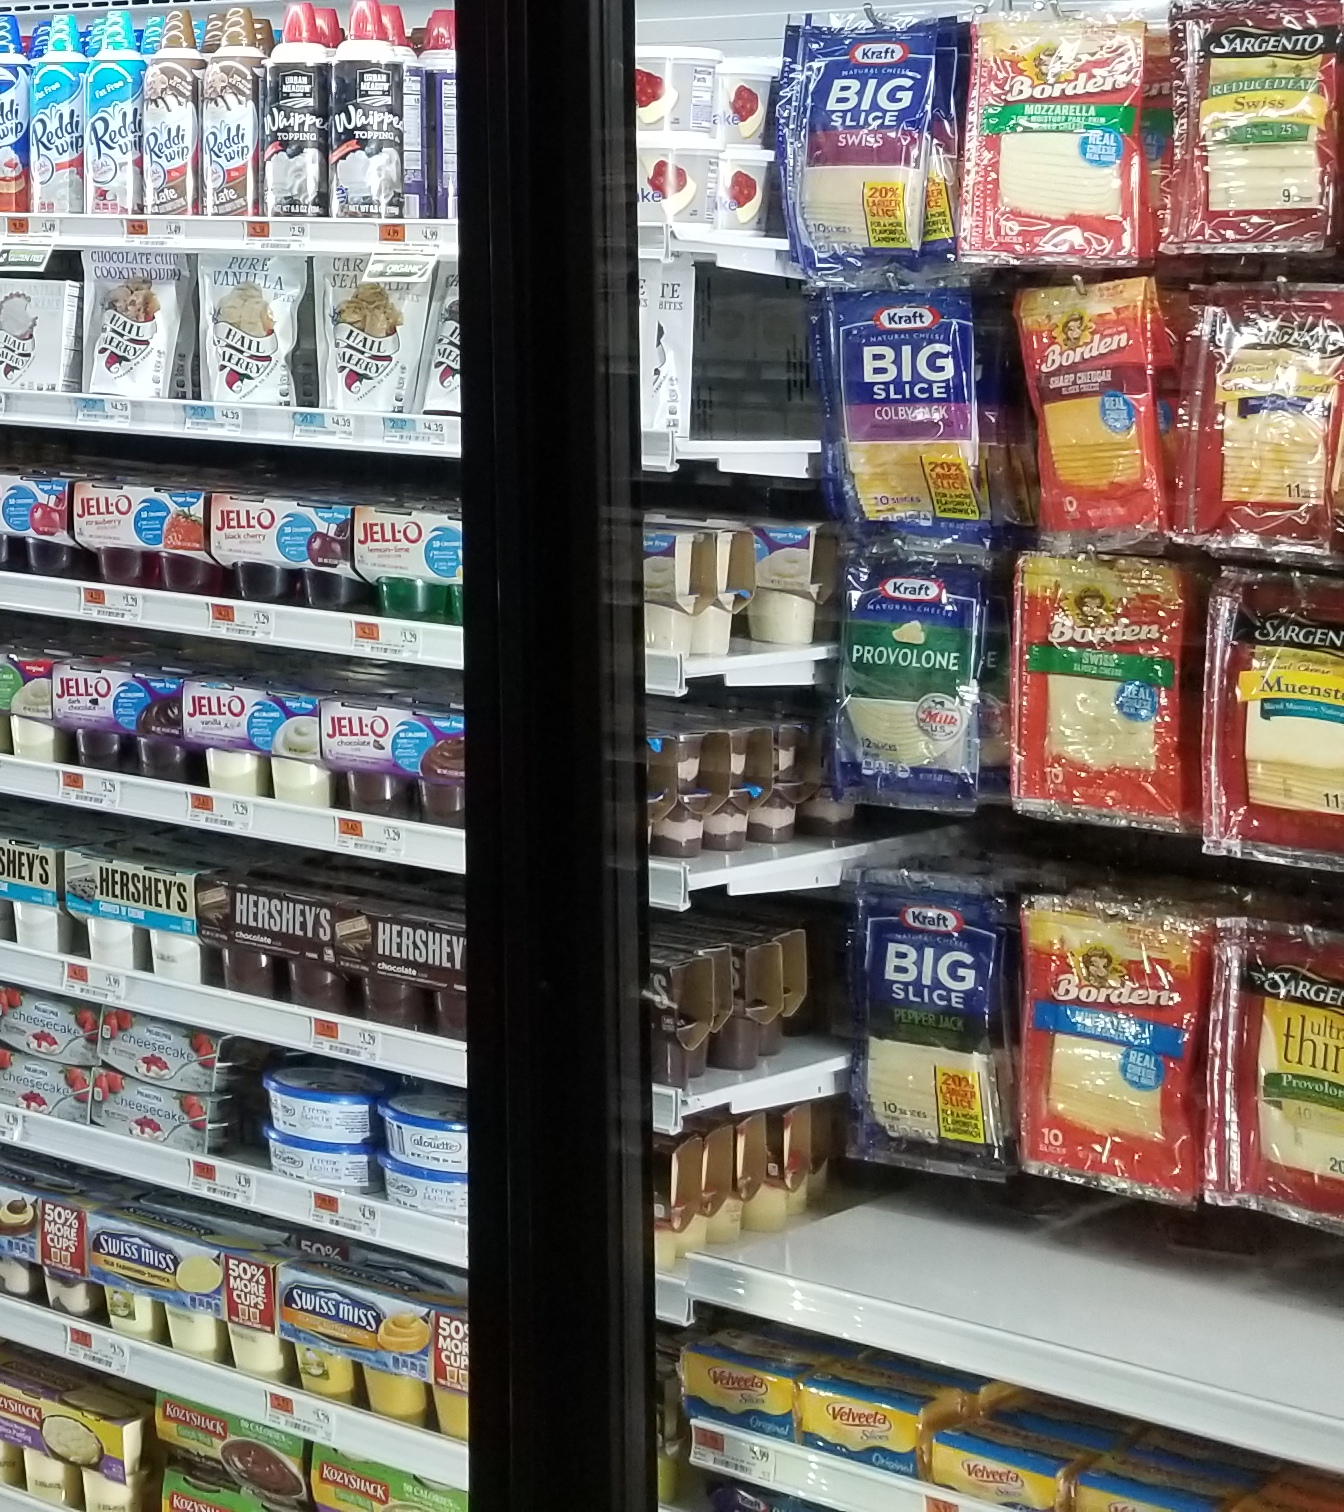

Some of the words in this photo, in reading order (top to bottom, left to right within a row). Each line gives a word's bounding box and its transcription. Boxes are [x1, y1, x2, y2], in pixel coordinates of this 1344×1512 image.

[861, 46, 896, 61] Kraft
[1210, 34, 1324, 55] SARGENTO
[826, 78, 915, 111] BIG
[1006, 73, 1129, 102] Borden
[1212, 80, 1278, 95] REDUCED
[1024, 104, 1096, 116] MOZZARELLA
[1233, 96, 1286, 112] Swiss
[830, 111, 898, 126] SLICE
[32, 108, 80, 160] Reddi
[204, 123, 246, 161] Reddi
[277, 132, 316, 141] TOPPING
[354, 130, 393, 140] TOPPING
[838, 133, 884, 147] SWISS
[1089, 133, 1117, 146] REAL
[146, 125, 186, 166] Reddi
[164, 143, 190, 163] wip
[224, 144, 249, 163] wip
[868, 186, 901, 198] 20%
[1282, 188, 1291, 203] 9
[91, 252, 152, 265] CHOCOLATE
[228, 257, 271, 272] PURE
[94, 266, 138, 279] COOKIE
[213, 272, 284, 290] VANILLA
[110, 313, 145, 338] HAIL
[887, 310, 925, 325] Kraft
[4, 334, 28, 352] HAIL
[225, 328, 265, 353] HAIL
[345, 329, 387, 353] HAIL
[870, 333, 910, 342] NATURAL
[913, 333, 944, 341] CHEESE
[338, 350, 384, 375] MERRY
[1040, 331, 1129, 373] Borden
[863, 343, 955, 383] BIG
[873, 384, 948, 399] SLICE
[76, 494, 132, 518] JELL-O
[215, 508, 275, 531] JELL-O
[224, 532, 241, 540] black
[243, 532, 266, 541] cherry
[358, 521, 423, 545] JELL-O
[892, 582, 930, 597] Kraft
[867, 604, 913, 612] NATURAL
[852, 645, 960, 672] PROVOLONE
[55, 676, 111, 699] JELL-O
[187, 695, 246, 718] JELL-O
[326, 715, 389, 738] JELL-O
[337, 739, 371, 747] chocolate
[99, 866, 188, 913] HERSHEY'S
[235, 892, 332, 941] HERSHEY'S
[911, 909, 949, 929] Kraft
[234, 931, 272, 945] chocolate
[377, 962, 418, 976] chocolate
[884, 942, 977, 990] BIG
[892, 982, 965, 1008] SLICE
[1052, 974, 1174, 1006] Borden
[12, 1009, 81, 1037] cheesecake
[894, 1008, 937, 1027] PEPPER
[121, 1032, 194, 1061] cheesecake
[1129, 1050, 1156, 1070] REAL
[2, 1072, 70, 1096] cheesecake
[114, 1095, 185, 1123] cheesecake
[413, 1136, 459, 1151] alouette
[1042, 1128, 1063, 1146] 10
[45, 1203, 79, 1228] 50%
[44, 1221, 77, 1240] MORE
[46, 1233, 77, 1253] CUPS
[99, 1235, 139, 1260] SWISS
[141, 1244, 176, 1273] MISS
[228, 1258, 265, 1284] 50%
[229, 1277, 265, 1298] MORE
[233, 1291, 265, 1310] CUPS
[292, 1288, 336, 1316] SWISS
[338, 1303, 377, 1331] MISS
[712, 1369, 763, 1389] Velveeta
[166, 1402, 224, 1436] KOZYSHACK
[831, 1405, 887, 1426] Velveeta
[322, 1464, 386, 1501] KOZYSHACK
[966, 1463, 1020, 1484] Velveeta
